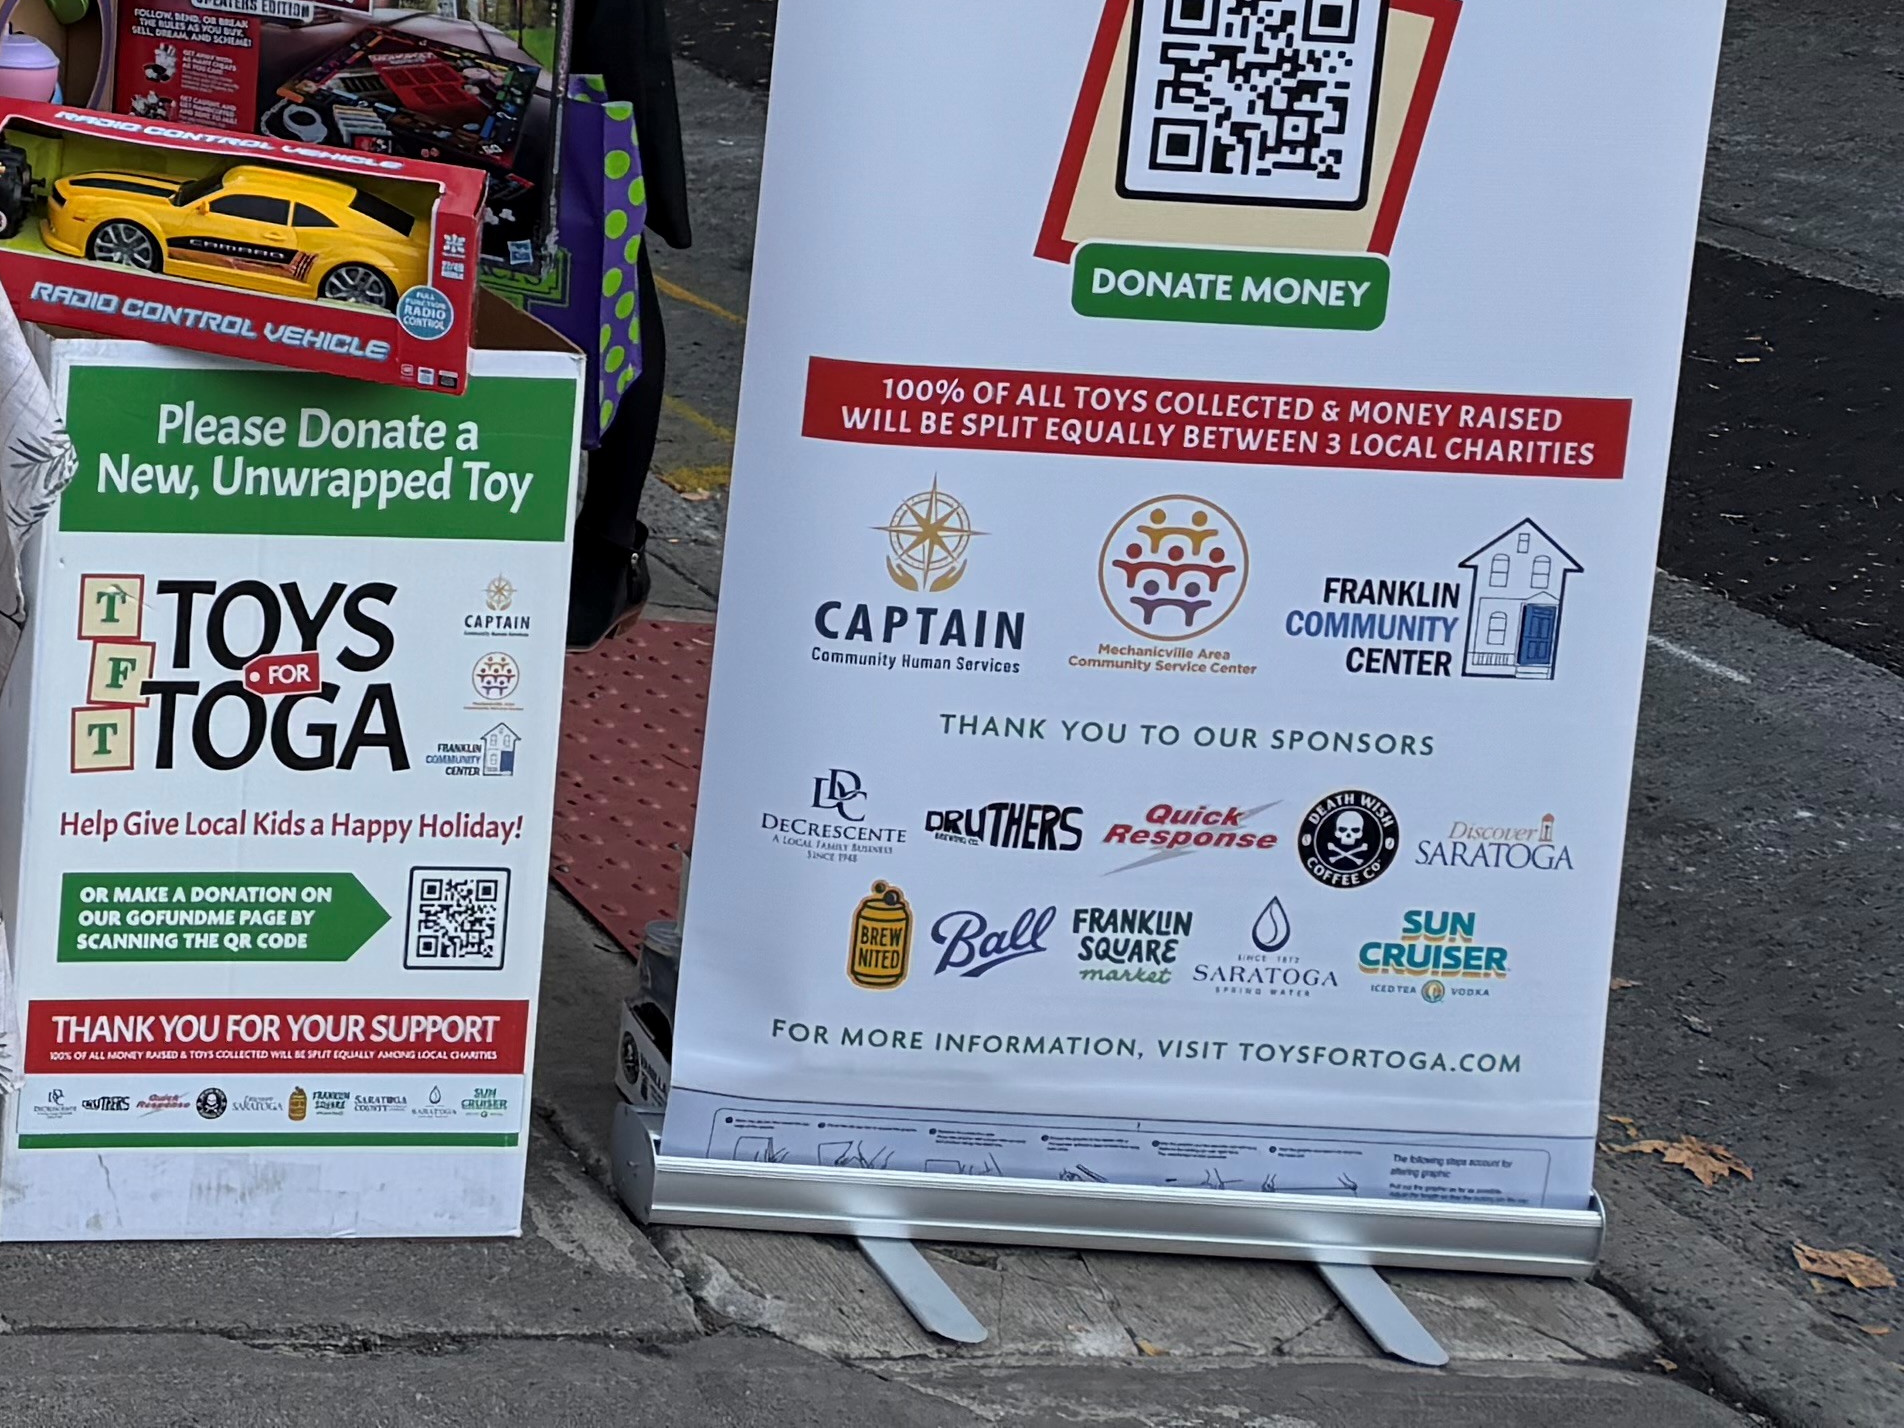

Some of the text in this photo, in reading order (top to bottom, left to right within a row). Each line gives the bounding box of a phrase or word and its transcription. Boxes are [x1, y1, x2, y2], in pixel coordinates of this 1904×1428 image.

[1092, 268, 1371, 307] DONATE MONEY
[29, 280, 391, 360] RADIO CONTROL VEHICLE
[883, 378, 1562, 431] 100% OF ALL TOYS COLLECTED & MONEY RAISED
[842, 406, 1594, 465] WILL BE SPLIT EQUALLY BETWEEN 3 LOCAL CHARITIES
[1323, 577, 1460, 609] FRANKLIN
[157, 580, 397, 673] TOYS
[815, 601, 1025, 650] CAPTAIN
[1284, 609, 1458, 644] COMMUNITY
[812, 646, 1020, 673] Community Human Services
[1068, 655, 1257, 674] Community Service Center
[1098, 643, 1230, 660] Mechanicville Area
[1346, 647, 1452, 677] CENTER
[269, 664, 311, 684] FOR
[140, 680, 410, 771] TOGA
[940, 714, 1433, 756] THANK YOU TO OUR SPONSORS
[1145, 803, 1245, 827] Quick
[1308, 793, 1394, 828] DEATH WISH
[60, 809, 523, 846] Help Give Local Kids a Happy Holiday!
[925, 802, 1083, 851] DRUTHERS
[1102, 823, 1279, 850] Response
[1448, 820, 1539, 842] Discover
[1415, 840, 1574, 870] SARATOGA
[1306, 856, 1361, 886] COFFEE
[80, 886, 332, 903] OR MAKE A DONATION ON
[78, 910, 316, 926] OUR GOFUNDME PAGE BY
[1073, 907, 1193, 937] FRANKLIN
[1402, 910, 1475, 936] SUN
[77, 933, 307, 952] SCANNING THE QR CODE
[860, 924, 904, 947] BREW
[931, 906, 1056, 978] Ball
[857, 948, 901, 970] NITED
[1078, 936, 1179, 966] SQUARE
[1359, 942, 1507, 974] CRUISER
[1079, 967, 1172, 986] market
[1193, 964, 1338, 987] SARATOGA
[1370, 984, 1490, 997] ICED TEA VODKA
[772, 1019, 1520, 1072] FOR MORE INFORMATION, VISIT TOYSFORTOGA.COM
